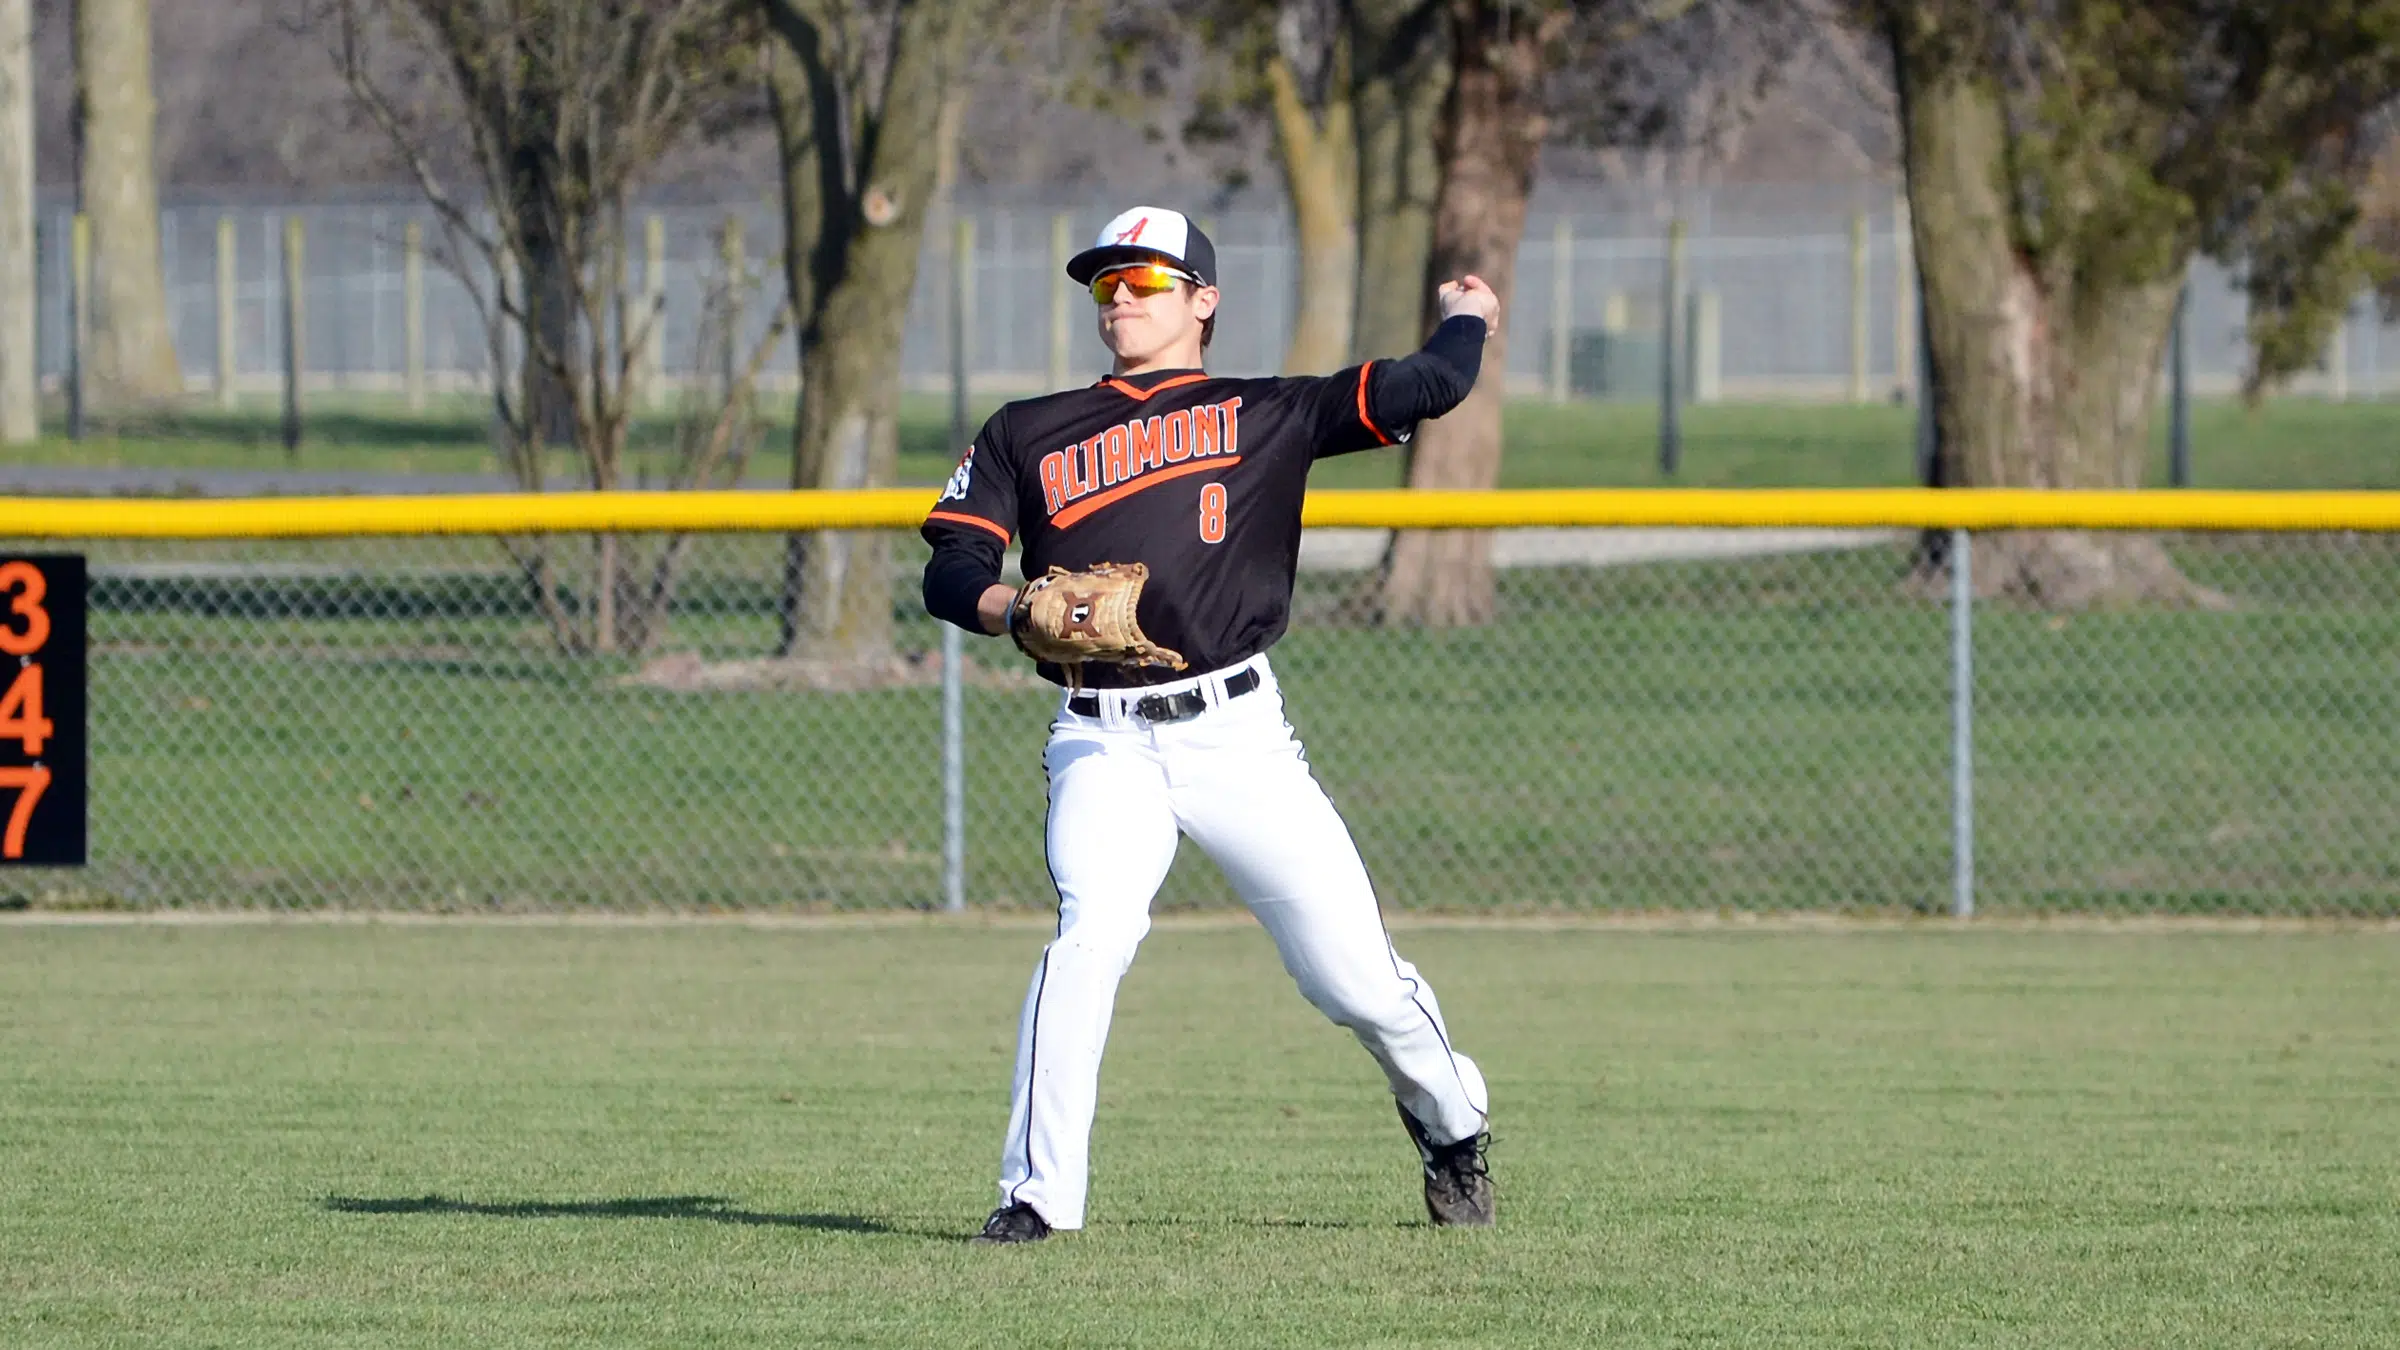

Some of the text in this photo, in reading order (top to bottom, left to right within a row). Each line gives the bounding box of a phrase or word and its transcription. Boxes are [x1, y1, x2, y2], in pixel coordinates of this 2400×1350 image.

[1116, 216, 1148, 247] A
[1040, 396, 1242, 515] ALTAMONT
[1200, 482, 1228, 543] 8
